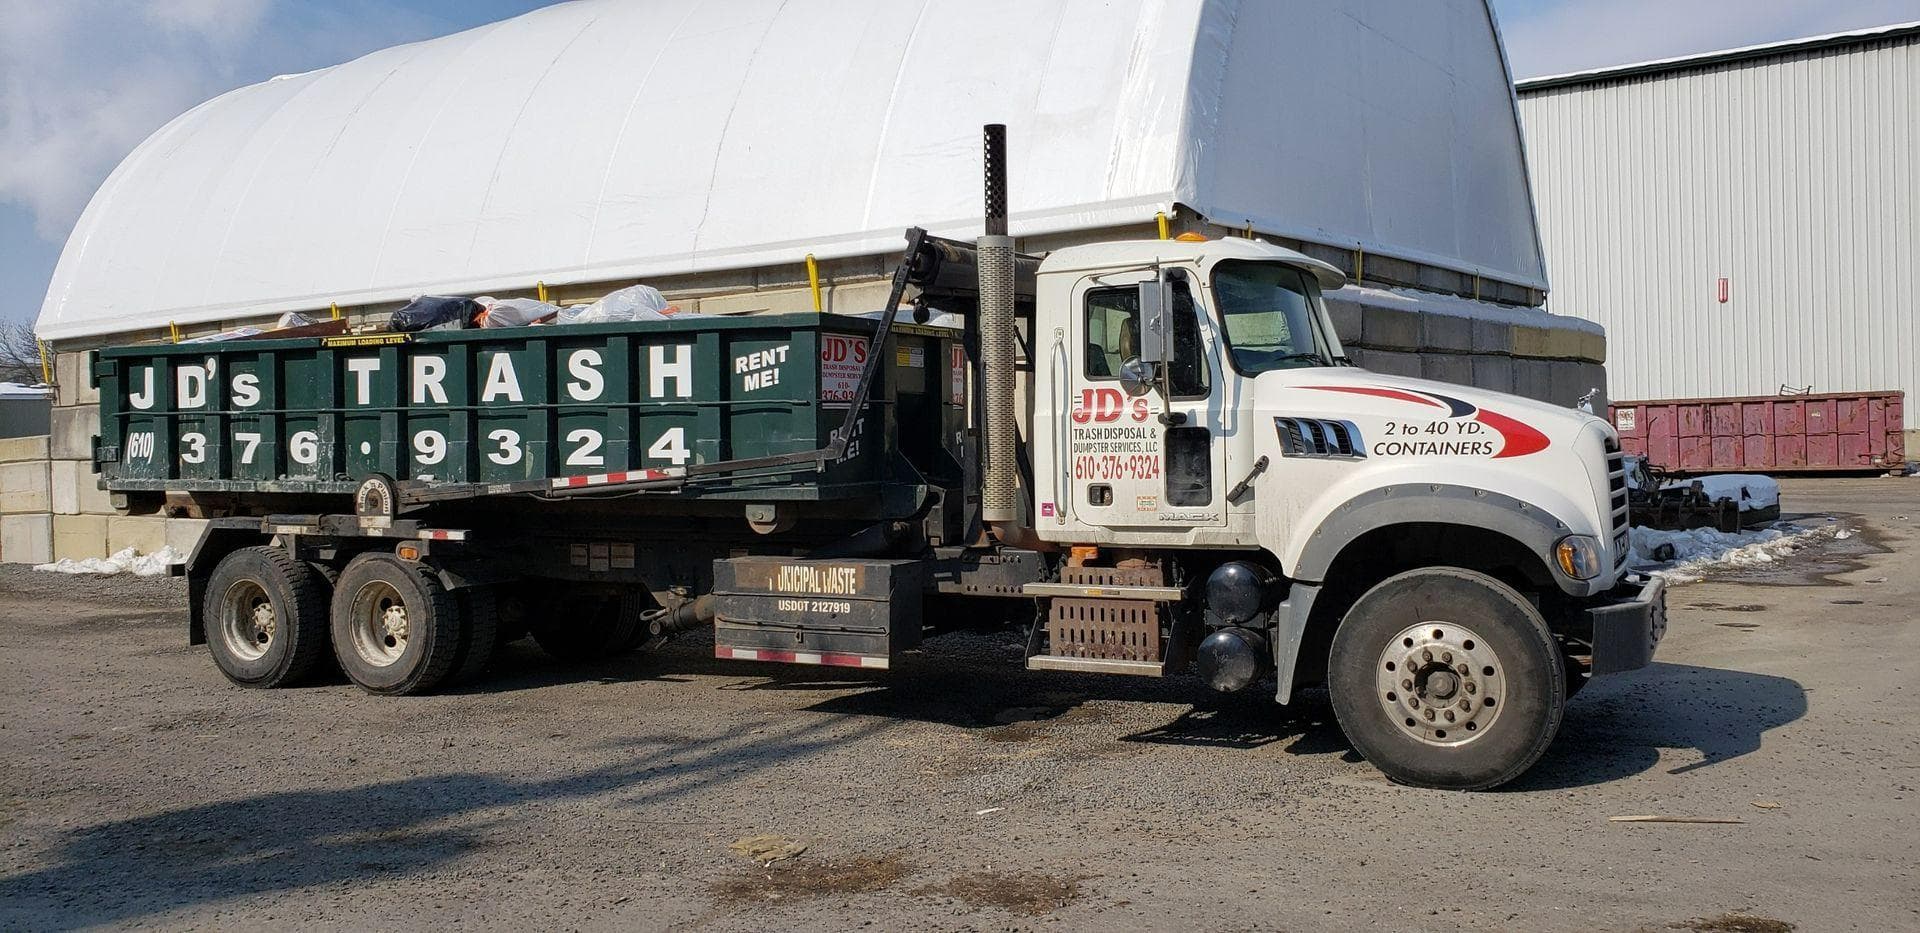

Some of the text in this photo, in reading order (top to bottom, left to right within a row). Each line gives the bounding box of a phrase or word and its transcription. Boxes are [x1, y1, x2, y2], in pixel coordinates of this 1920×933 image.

[822, 337, 866, 364] JD'S
[735, 345, 790, 374] RENT
[744, 368, 780, 392] ME!
[1074, 427, 1157, 440] TRASH DISPOSAL &
[1385, 421, 1485, 435] 2 to 40 YD.
[127, 432, 154, 464] (610)
[1074, 442, 1109, 453] DUMPSTER
[1146, 442, 1158, 453] LLC
[1374, 441, 1493, 455] CONTAINERS
[1159, 512, 1219, 521] MACK
[823, 567, 856, 594] WASTE
[779, 600, 850, 613] USDOT 2127919
